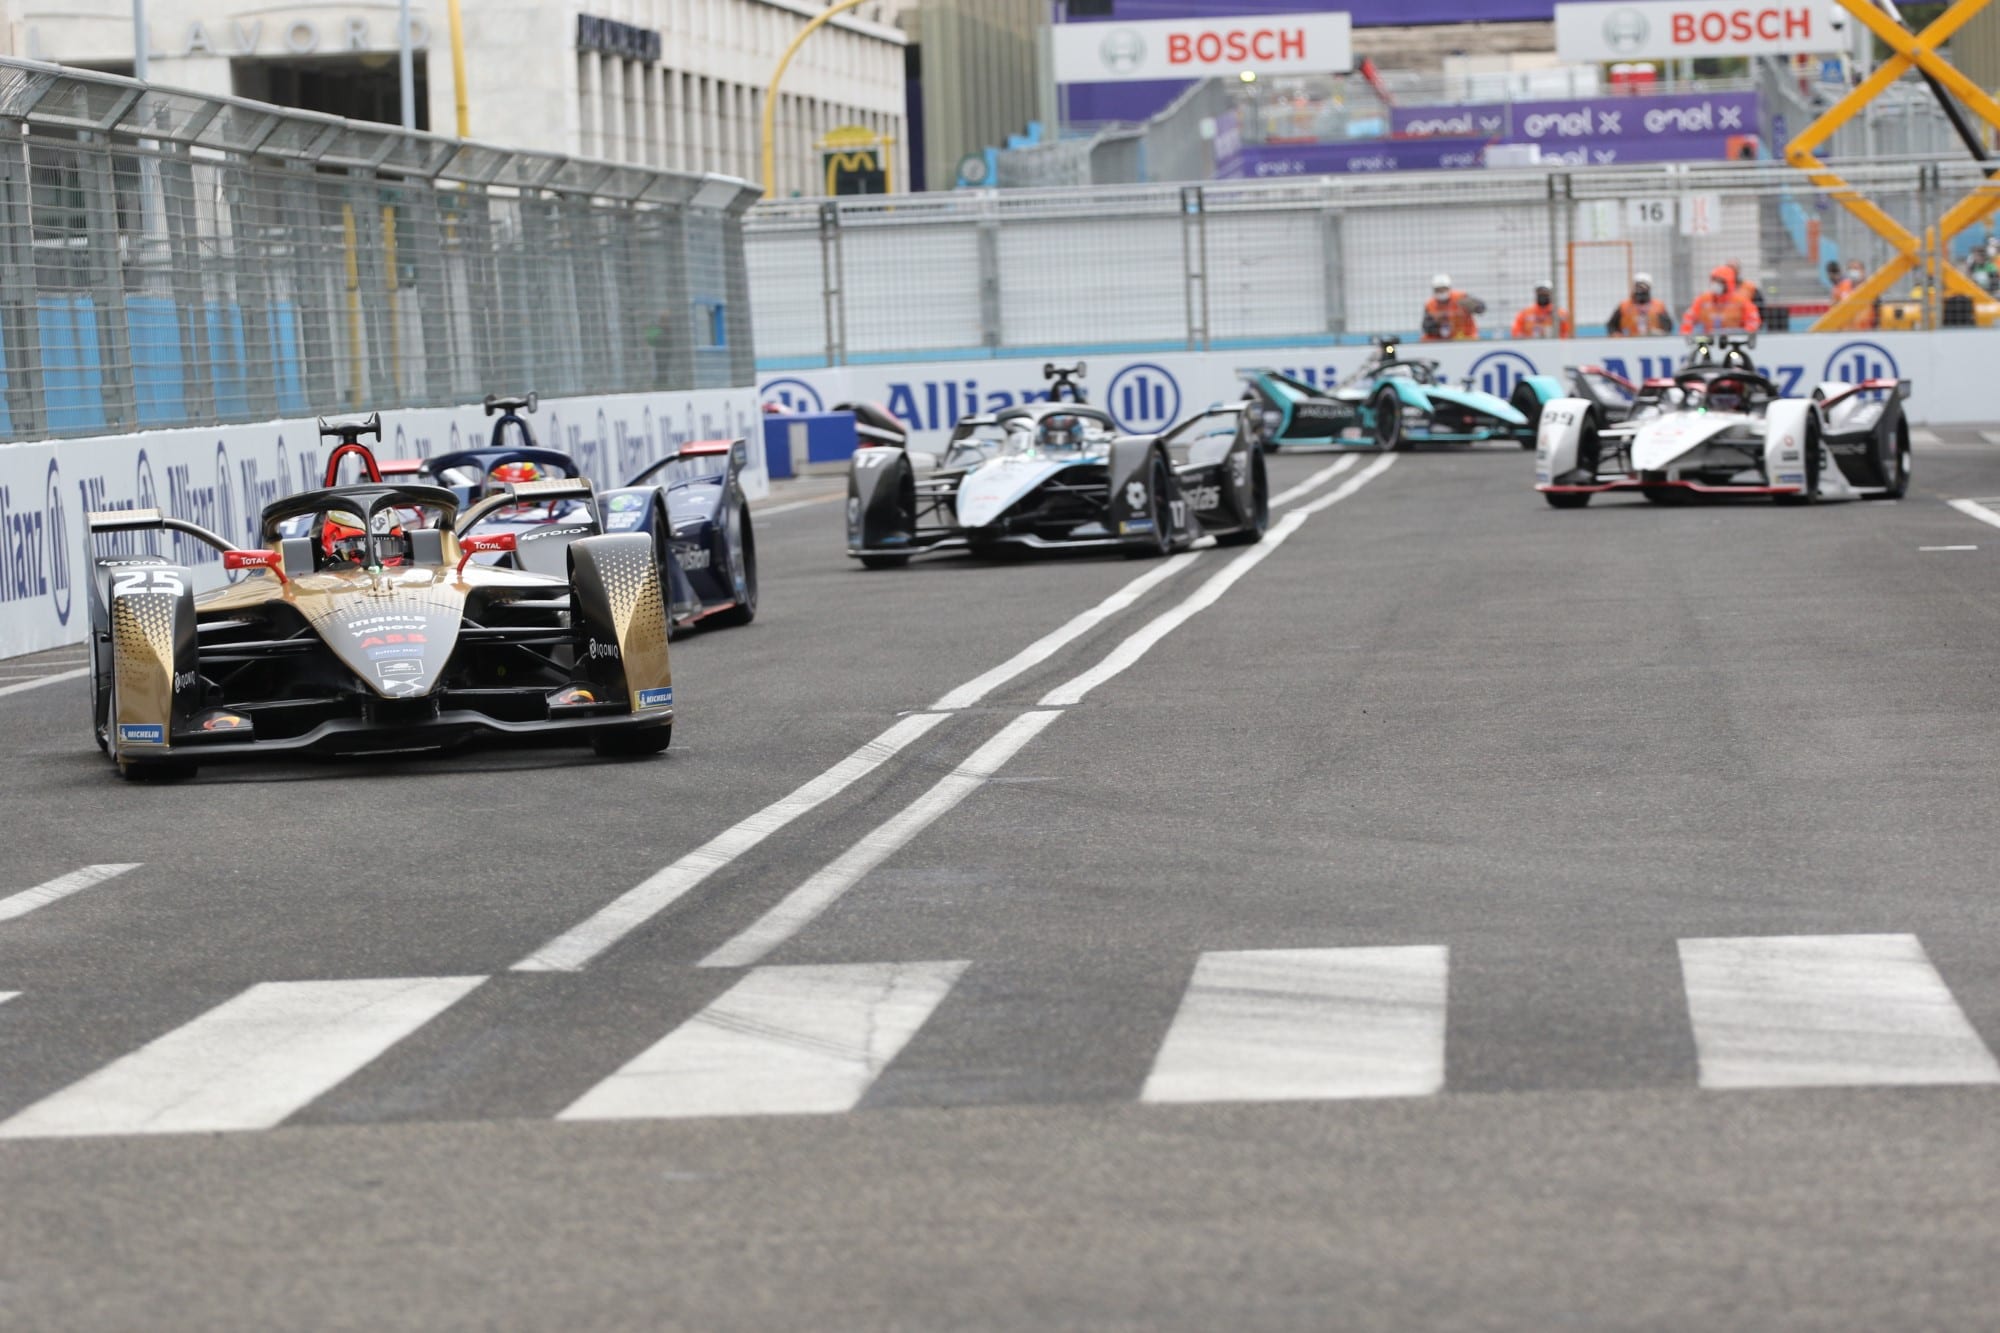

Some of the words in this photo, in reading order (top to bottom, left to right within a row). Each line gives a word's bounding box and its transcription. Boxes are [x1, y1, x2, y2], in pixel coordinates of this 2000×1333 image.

[1672, 8, 1811, 44] BOSCH
[1168, 29, 1306, 64] BOSCH
[1639, 203, 1664, 221] 16
[856, 452, 888, 469] 17
[167, 463, 219, 567] Allianz
[113, 570, 184, 598] 25
[360, 633, 428, 649] ABB
[646, 694, 672, 704] MICHELIN
[127, 730, 160, 739] MICHELIN
